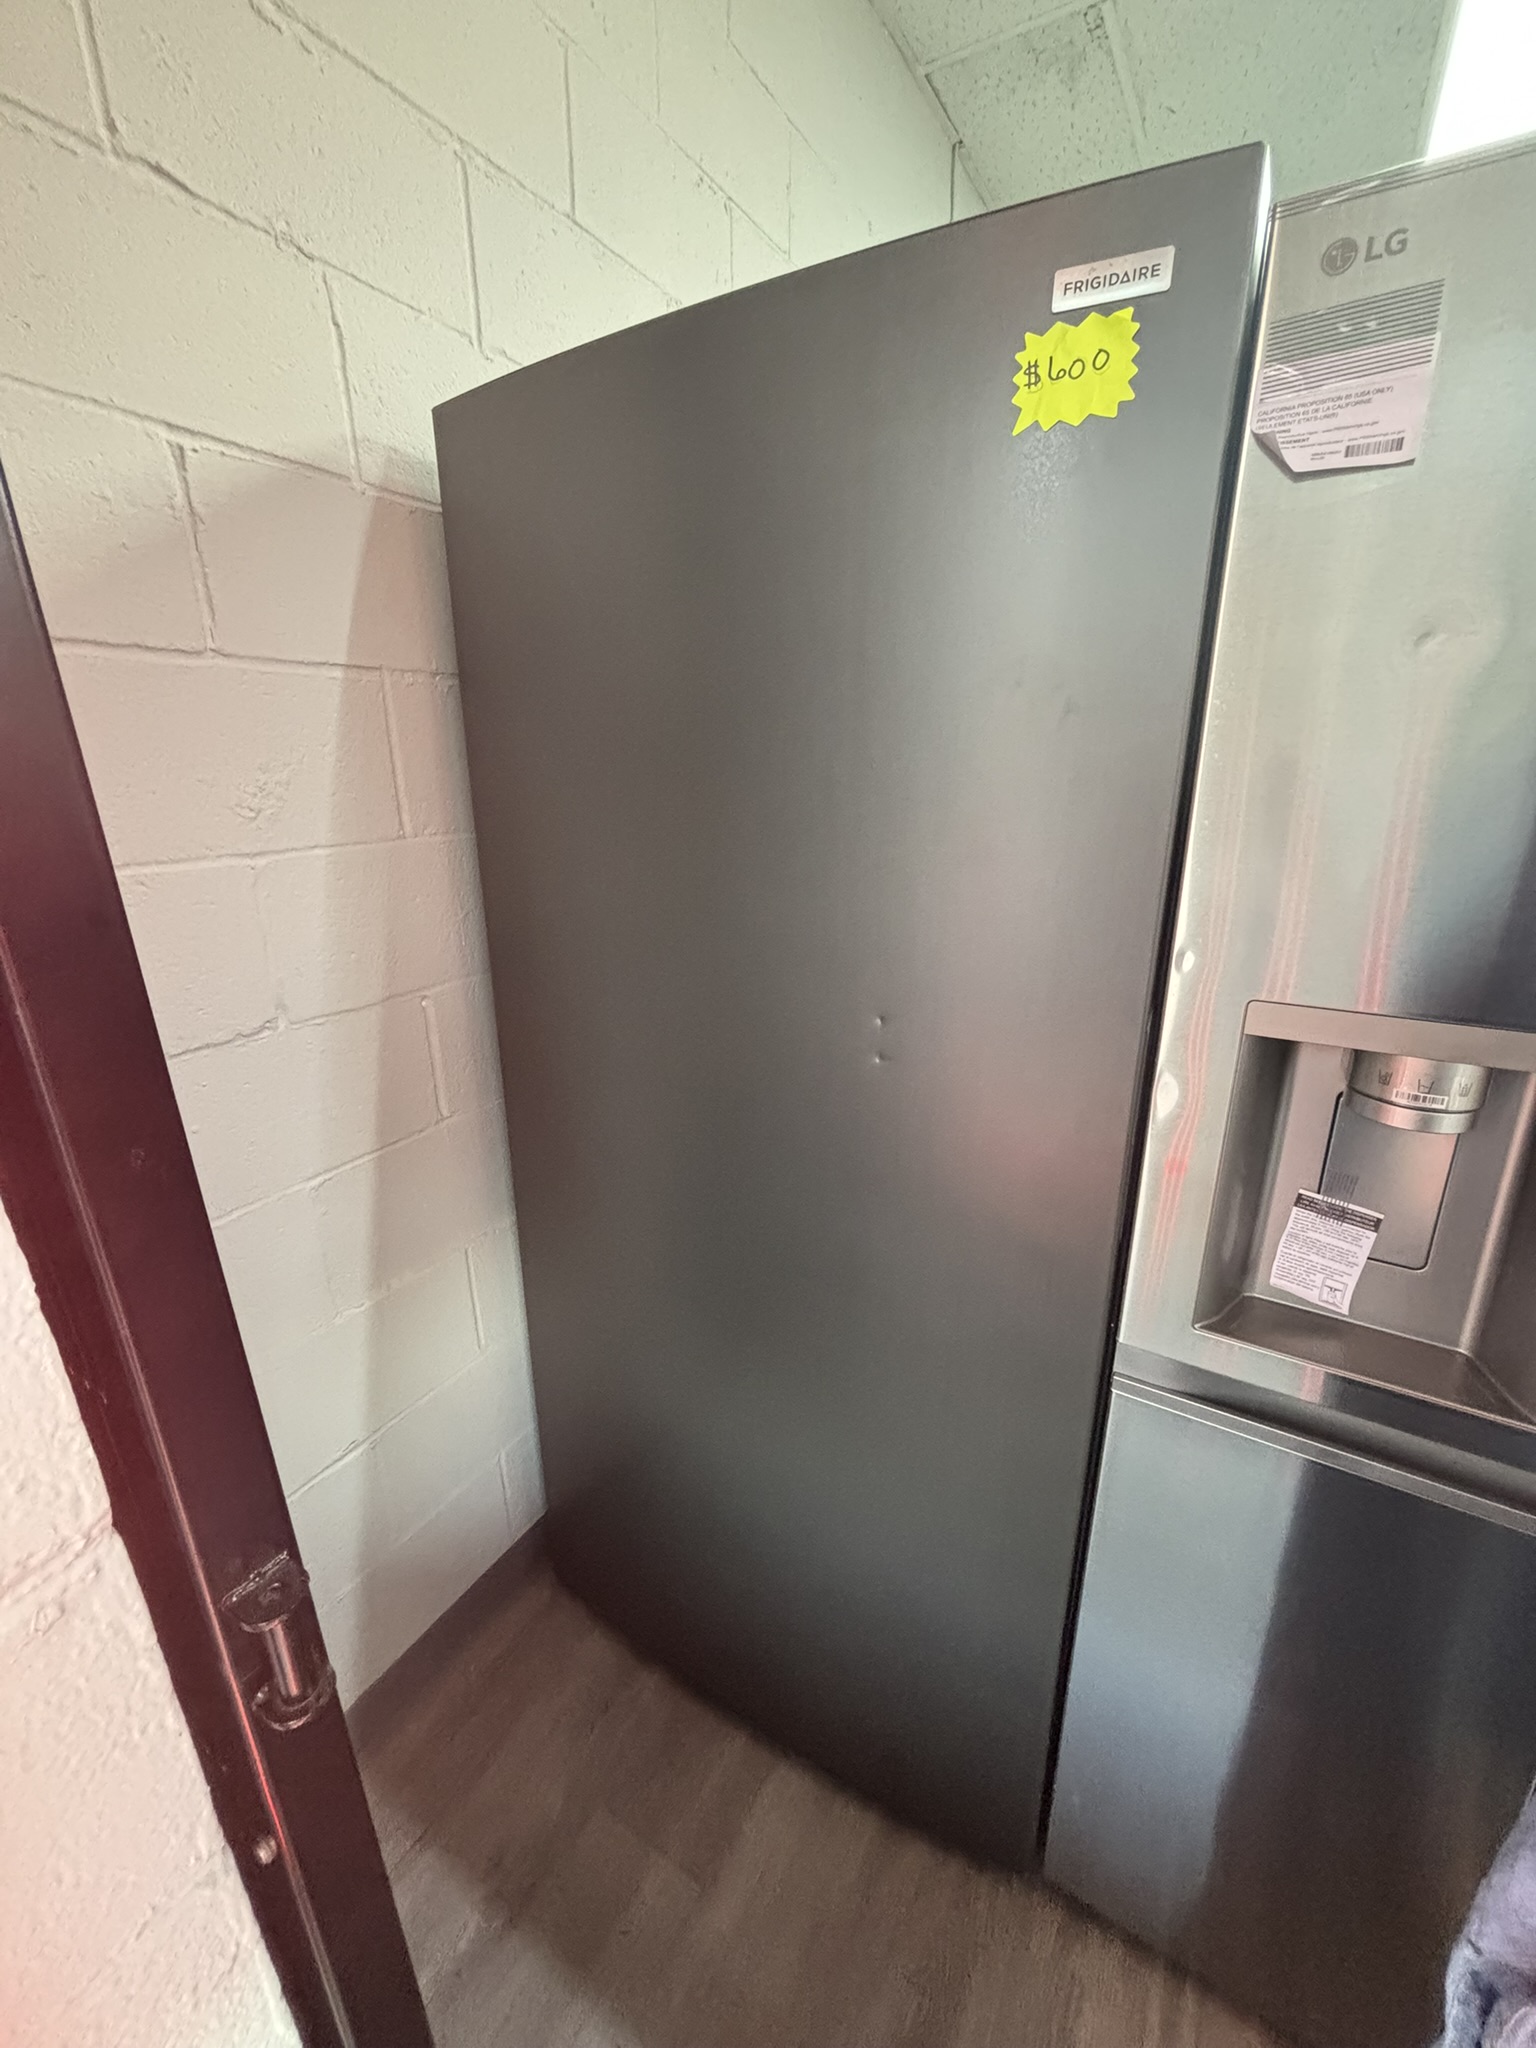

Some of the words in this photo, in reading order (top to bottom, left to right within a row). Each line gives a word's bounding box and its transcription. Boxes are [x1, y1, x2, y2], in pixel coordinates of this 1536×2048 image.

[1364, 228, 1409, 263] LG
[1063, 262, 1162, 296] FRIGIDAIRE
[1023, 348, 1110, 390] $600
[1256, 411, 1301, 424] PROPOSITION
[1322, 405, 1331, 413] LA
[1257, 404, 1296, 417] CALIFORNIA
[1297, 395, 1344, 409] PROPOSITION
